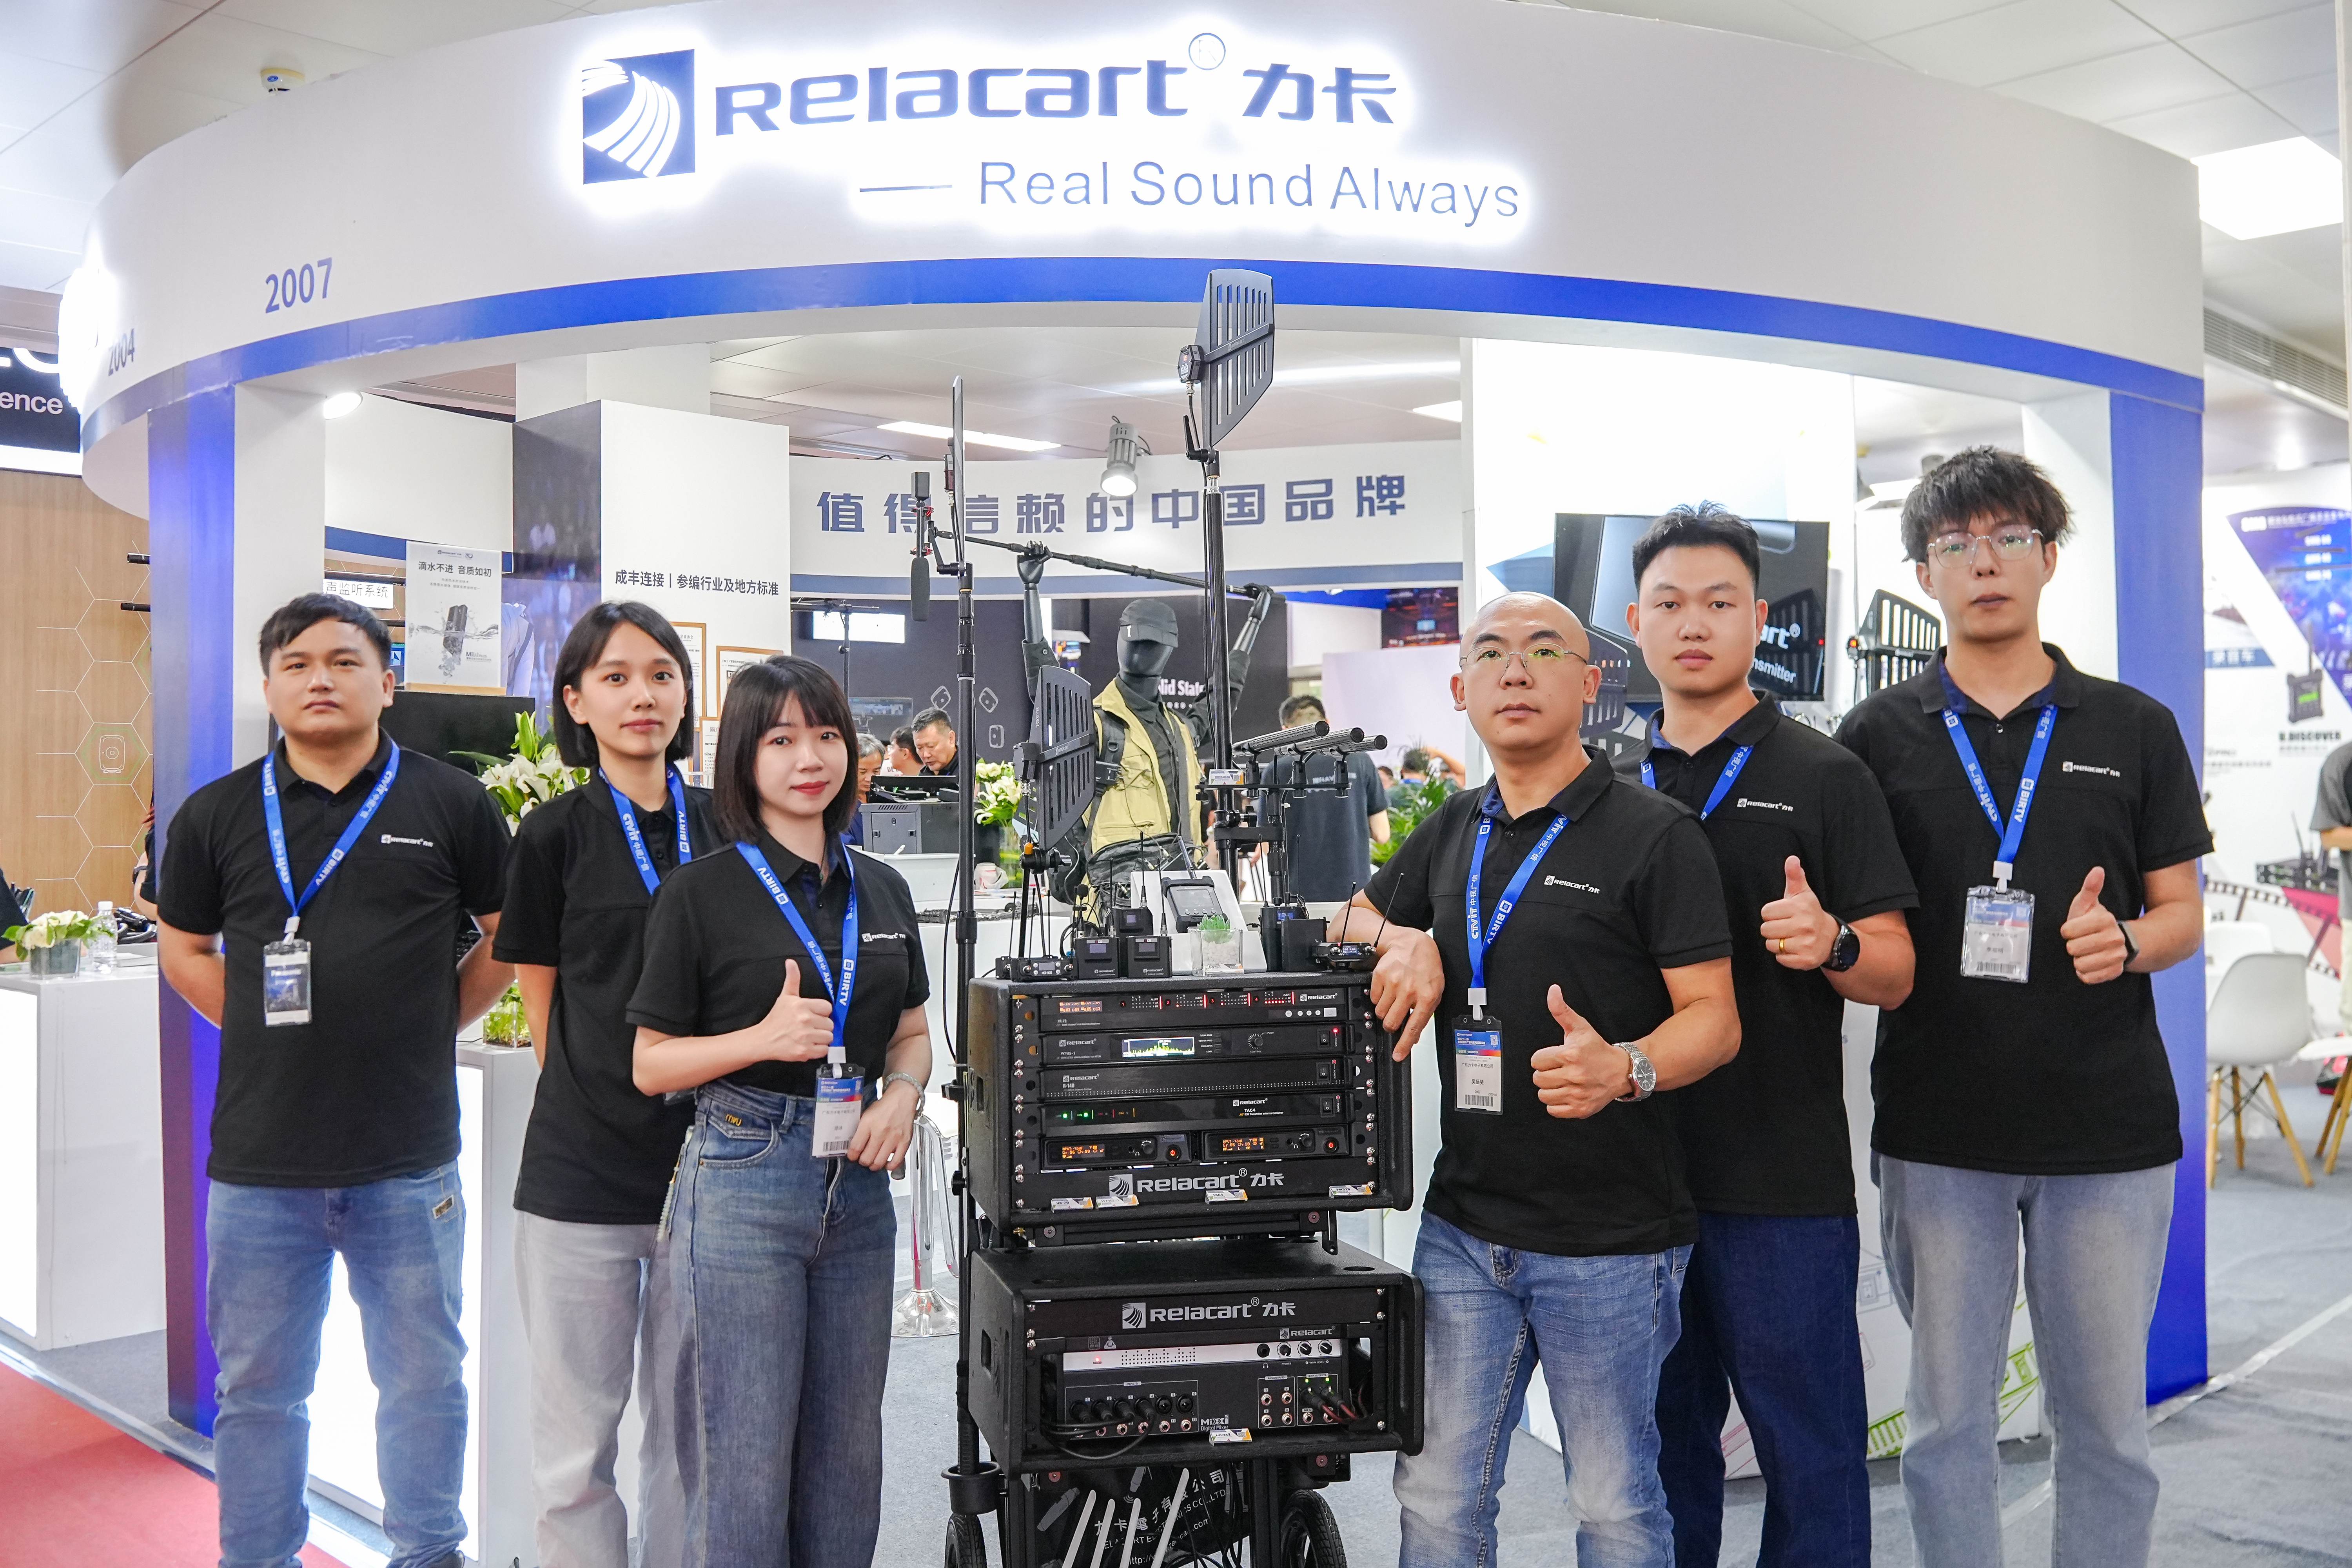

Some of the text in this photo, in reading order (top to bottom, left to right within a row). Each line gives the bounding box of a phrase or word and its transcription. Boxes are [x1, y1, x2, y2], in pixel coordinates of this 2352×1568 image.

[1241, 62, 1397, 125] 力卡
[979, 160, 1521, 229] Real Sound Always
[265, 257, 332, 314] 2007
[108, 328, 135, 377] 2004
[418, 561, 491, 577] 滴水不进 音质如初
[615, 570, 779, 595] 成丰连接 参编行业及地方标准
[326, 582, 388, 598] 声监听系统
[757, 867, 781, 894] BIRTV
[1470, 874, 1478, 906] 中视广信
[1487, 913, 1506, 944] BIRTV
[839, 972, 853, 1006] BIRTV
[1250, 1173, 1284, 1187] 力卡
[1262, 1302, 1296, 1317] 力卡
